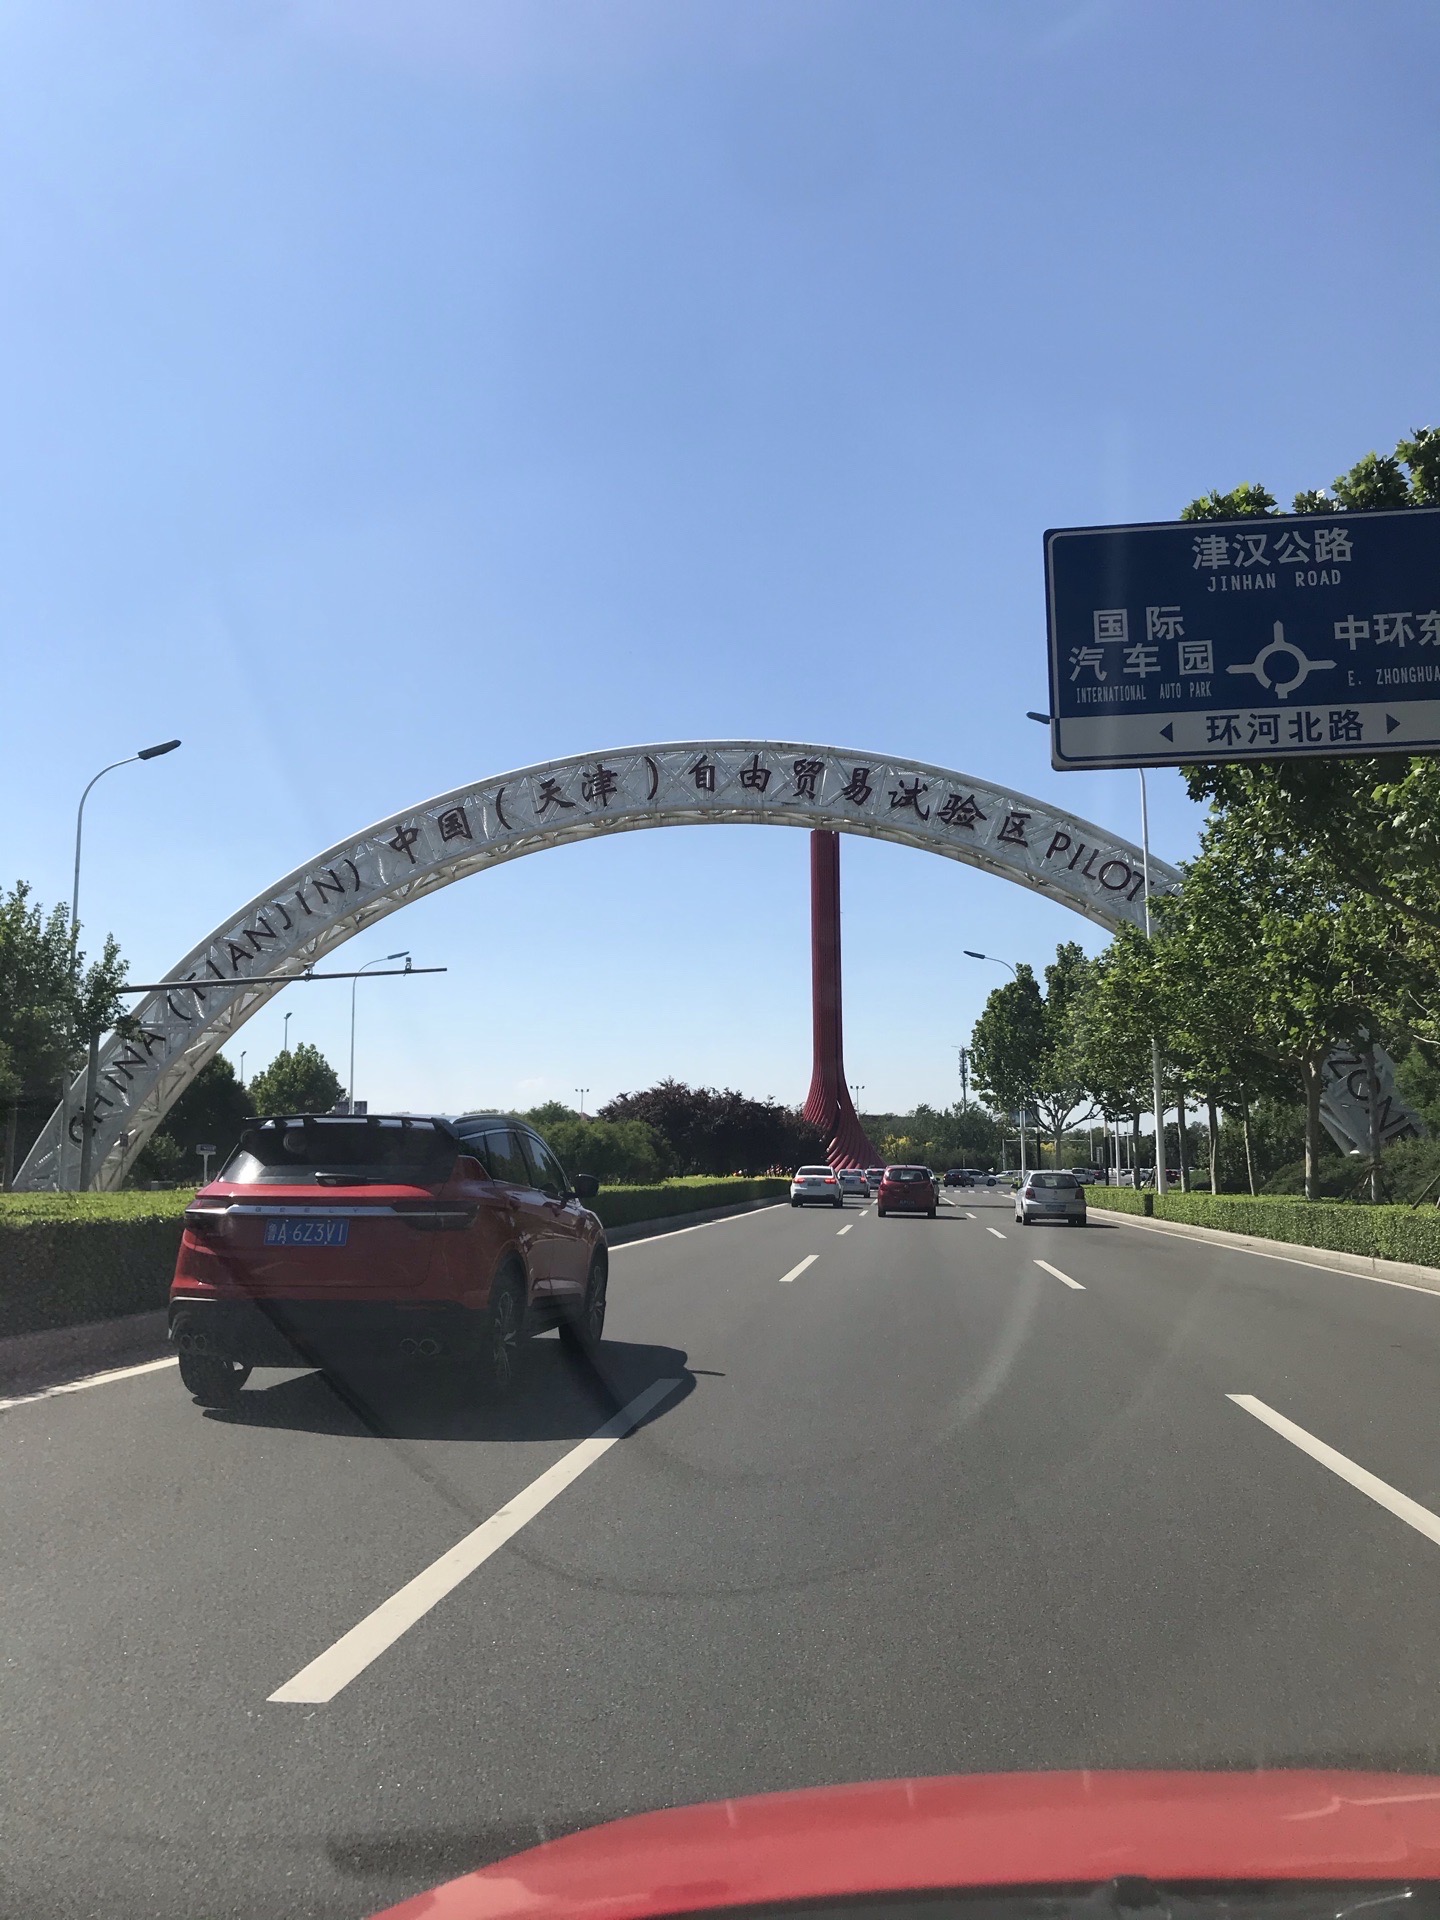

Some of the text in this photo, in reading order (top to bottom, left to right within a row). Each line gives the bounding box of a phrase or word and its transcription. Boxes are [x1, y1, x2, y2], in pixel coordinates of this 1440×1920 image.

[1191, 527, 1354, 571] 津汉公路
[1207, 569, 1342, 593] JINHAN ROAD
[1092, 605, 1186, 644] 国际
[1068, 639, 1215, 682] 汽车园
[1347, 670, 1362, 687] E.
[1076, 680, 1213, 704] INTERNATIONAL AUTO PARK
[1205, 709, 1364, 747] 环河北路
[1045, 831, 1155, 902] PILOT
